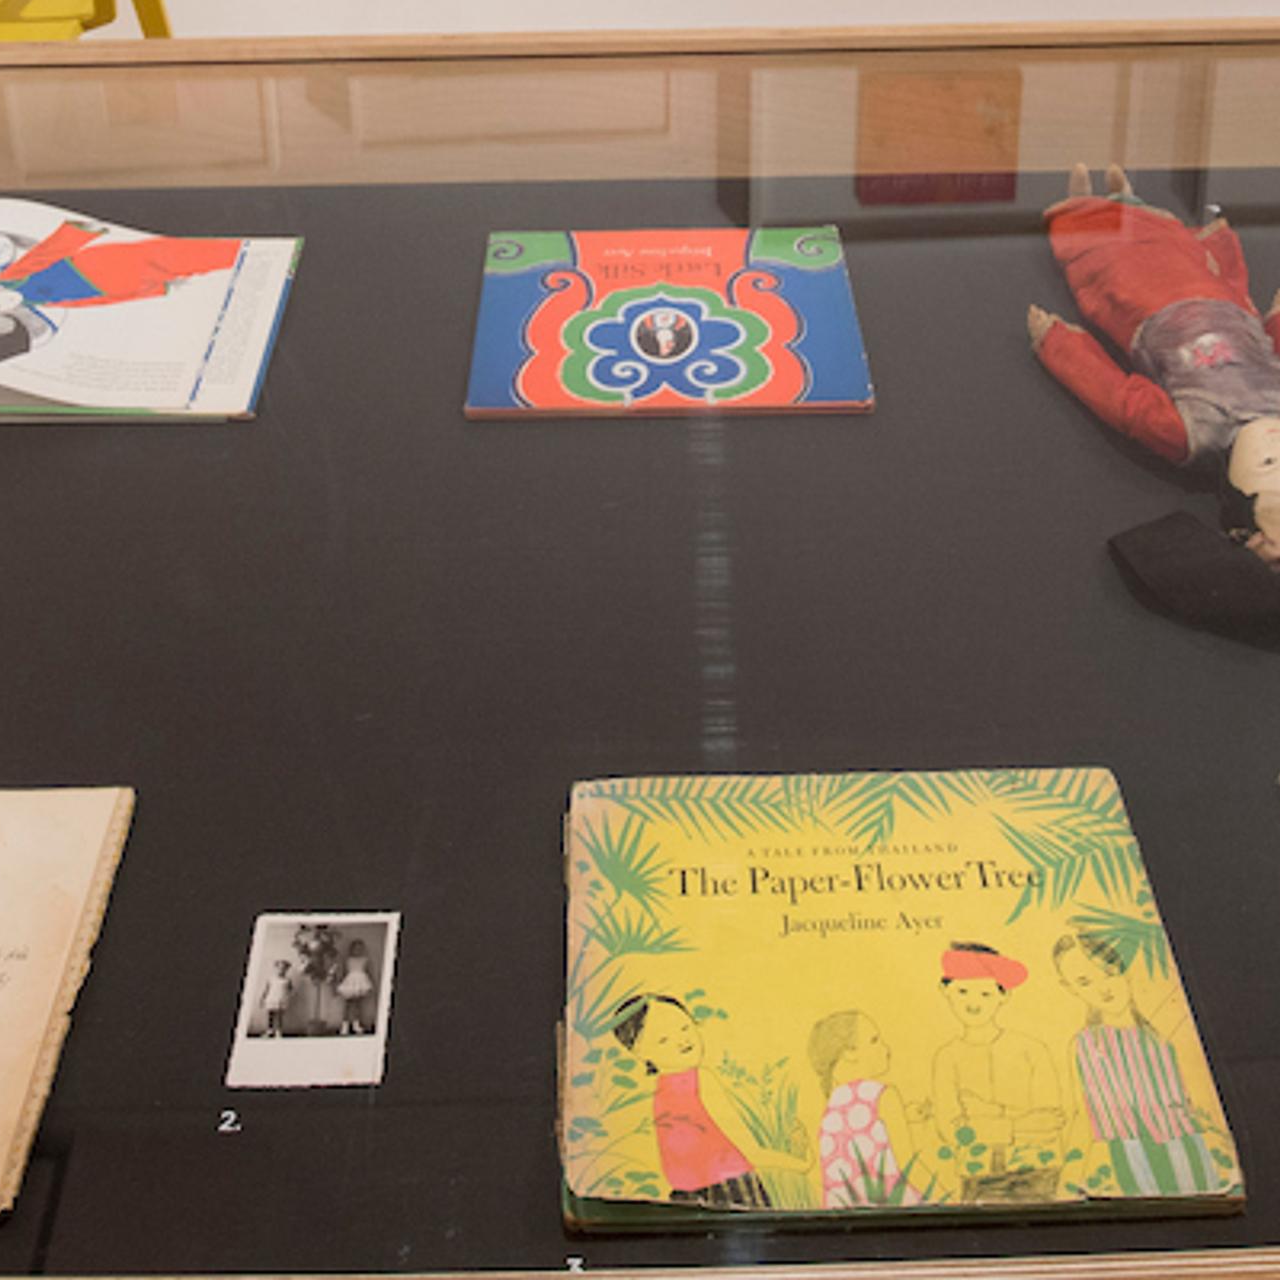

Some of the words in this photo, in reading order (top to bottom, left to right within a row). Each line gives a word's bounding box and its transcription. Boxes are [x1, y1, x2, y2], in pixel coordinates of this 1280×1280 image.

[763, 847, 803, 858] TALE
[812, 845, 859, 857] FROM
[668, 866, 738, 897] The
[749, 862, 965, 905] Paper-Flower
[965, 859, 1043, 889] Tree
[778, 911, 887, 938] Jacqueline
[895, 910, 943, 936] Ayer
